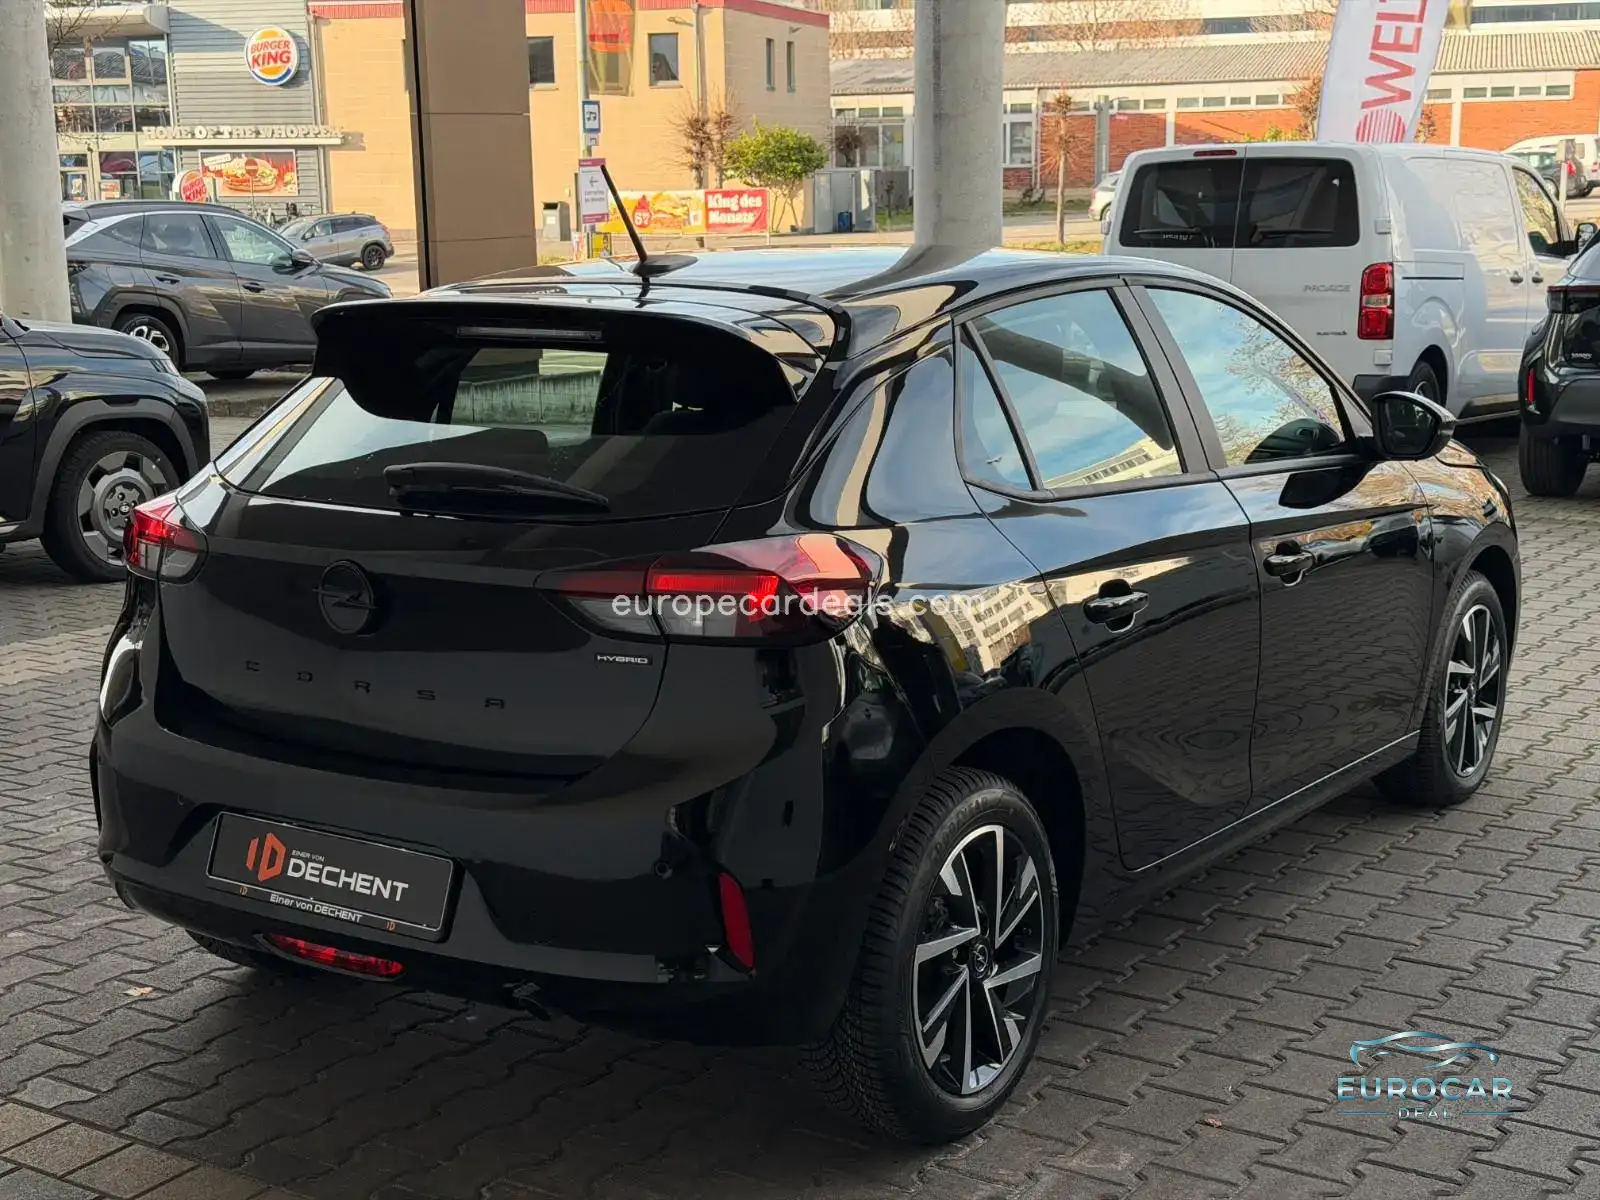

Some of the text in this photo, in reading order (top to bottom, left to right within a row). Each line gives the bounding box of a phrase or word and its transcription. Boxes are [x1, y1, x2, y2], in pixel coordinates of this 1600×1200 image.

[250, 40, 291, 53] BURGER
[251, 50, 291, 68] KING
[142, 126, 192, 139] HOME
[194, 125, 215, 139] OF
[215, 125, 255, 139] THE
[708, 194, 739, 211] King
[740, 194, 763, 208] des
[596, 654, 648, 664] HYBRID
[245, 660, 505, 709] CORSA
[291, 849, 325, 862] EINER VON
[287, 858, 409, 901] DECHENT
[269, 893, 364, 923] Einer von DECHENT
